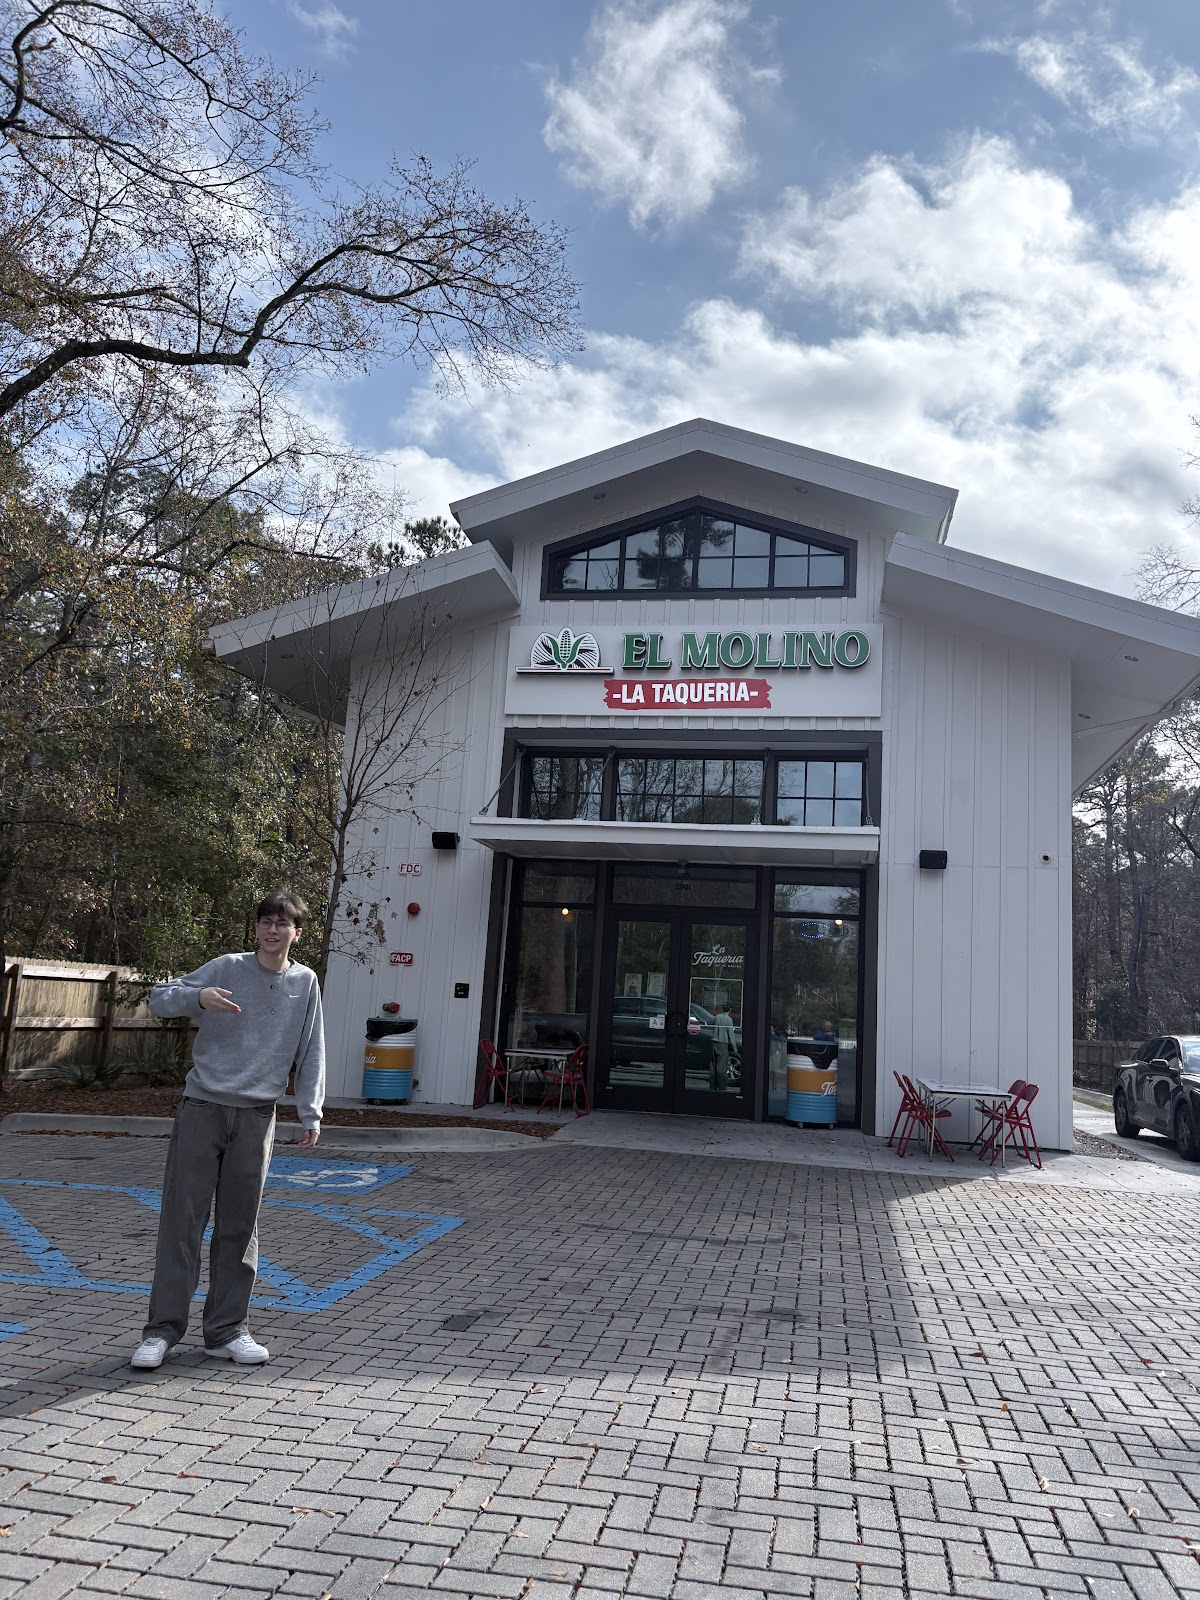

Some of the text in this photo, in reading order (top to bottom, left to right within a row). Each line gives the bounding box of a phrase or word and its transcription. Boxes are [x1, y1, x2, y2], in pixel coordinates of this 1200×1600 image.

[622, 630, 871, 670] EL MOLINO
[400, 863, 420, 873] FDC
[711, 943, 726, 955] La
[391, 953, 412, 963] FACP
[692, 951, 744, 968] Taqueria
